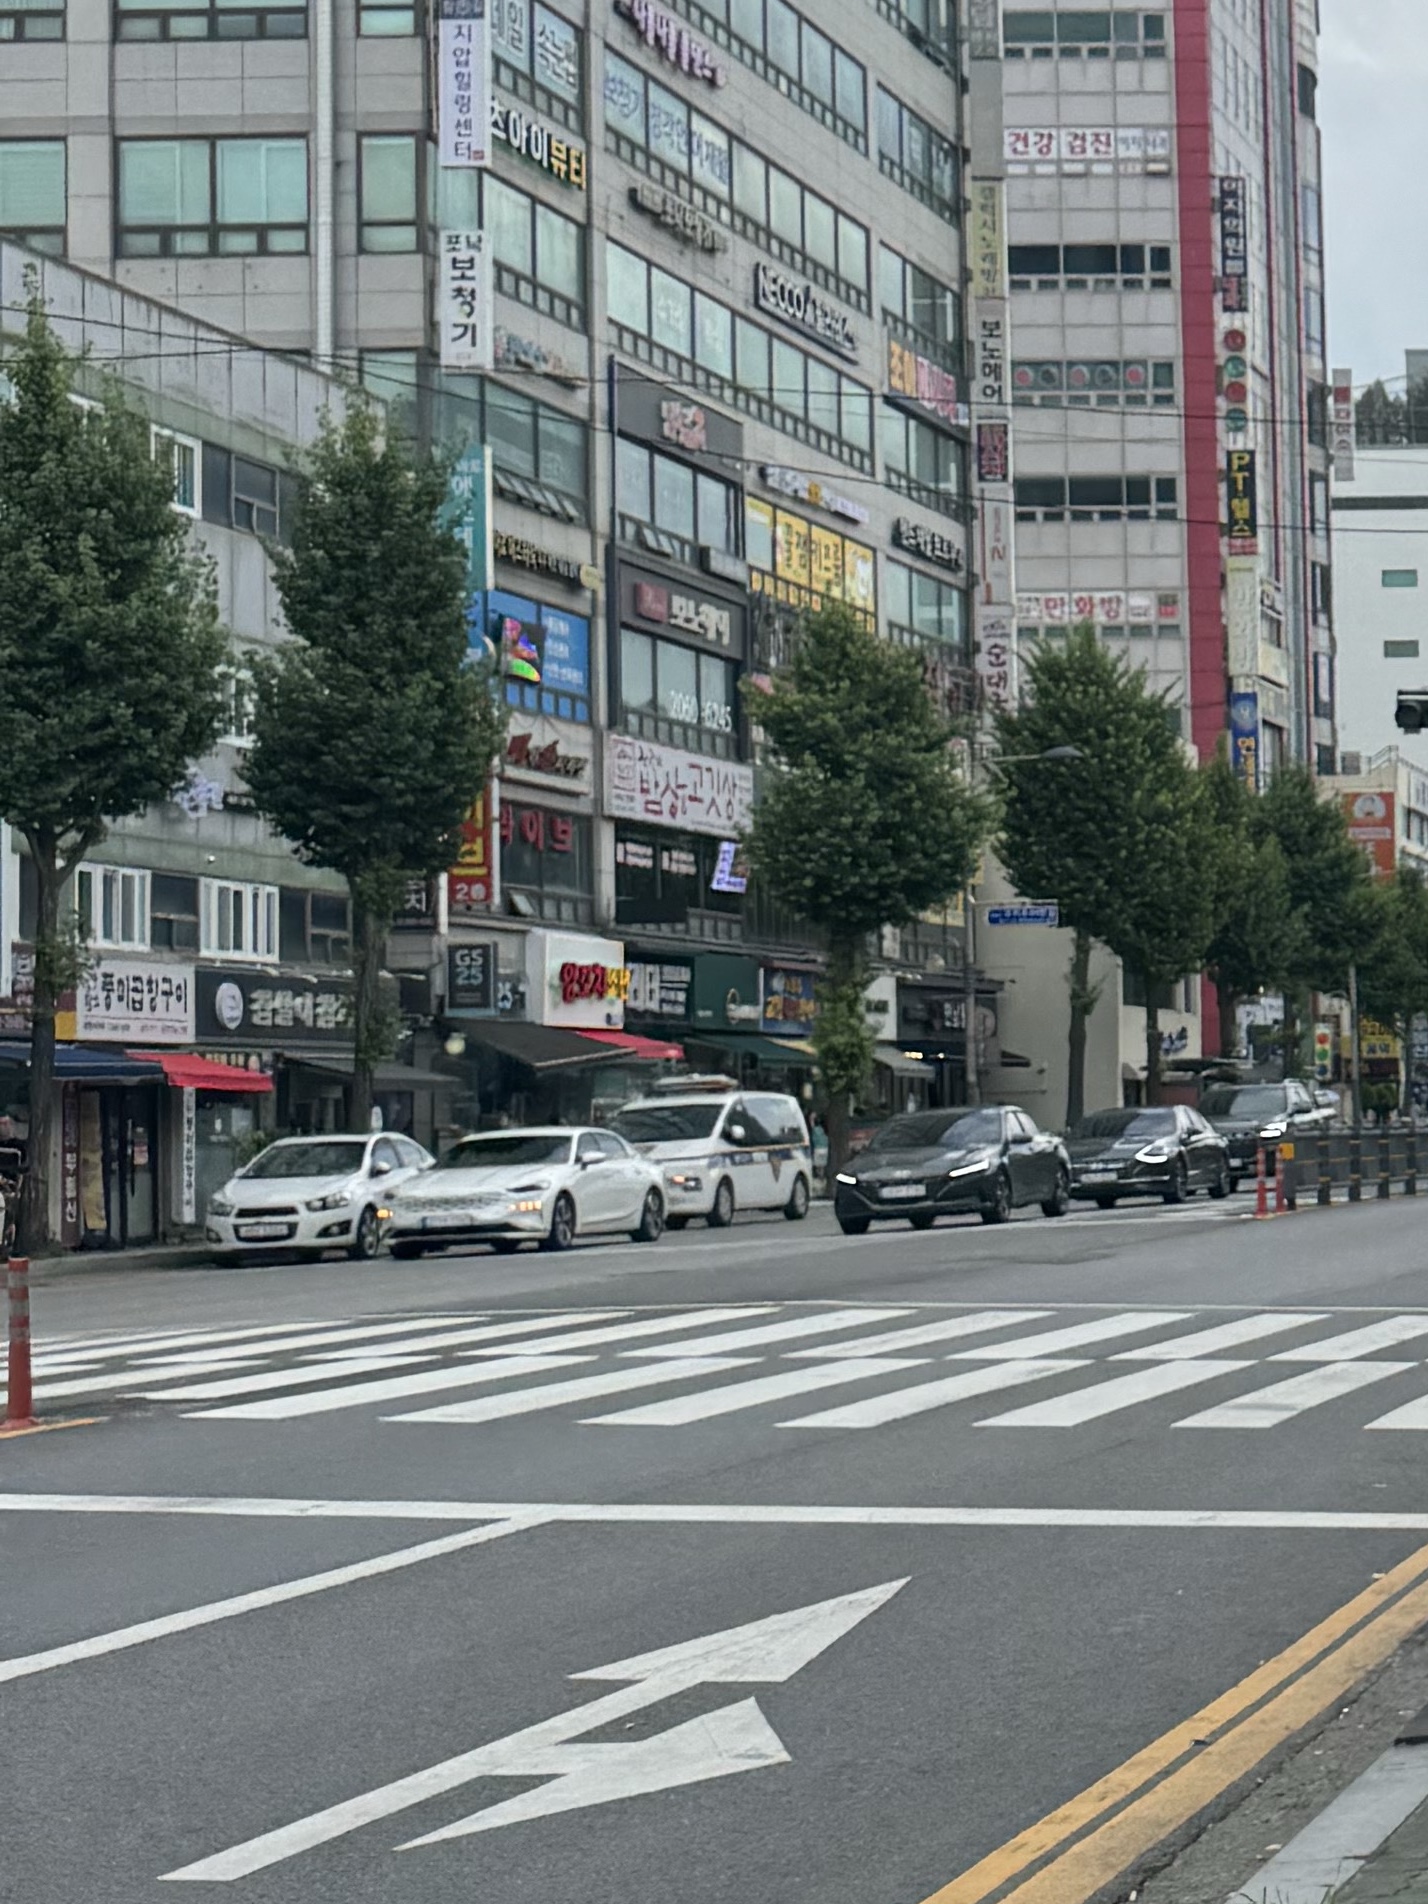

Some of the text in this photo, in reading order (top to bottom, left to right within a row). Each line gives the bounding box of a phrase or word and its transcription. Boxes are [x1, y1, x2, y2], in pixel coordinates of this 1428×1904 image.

[1008, 130, 1113, 158] 건강 검진
[451, 256, 477, 348] 보청기
[1043, 595, 1122, 620] 만화방
[455, 949, 484, 966] GS
[455, 969, 484, 985] 25
